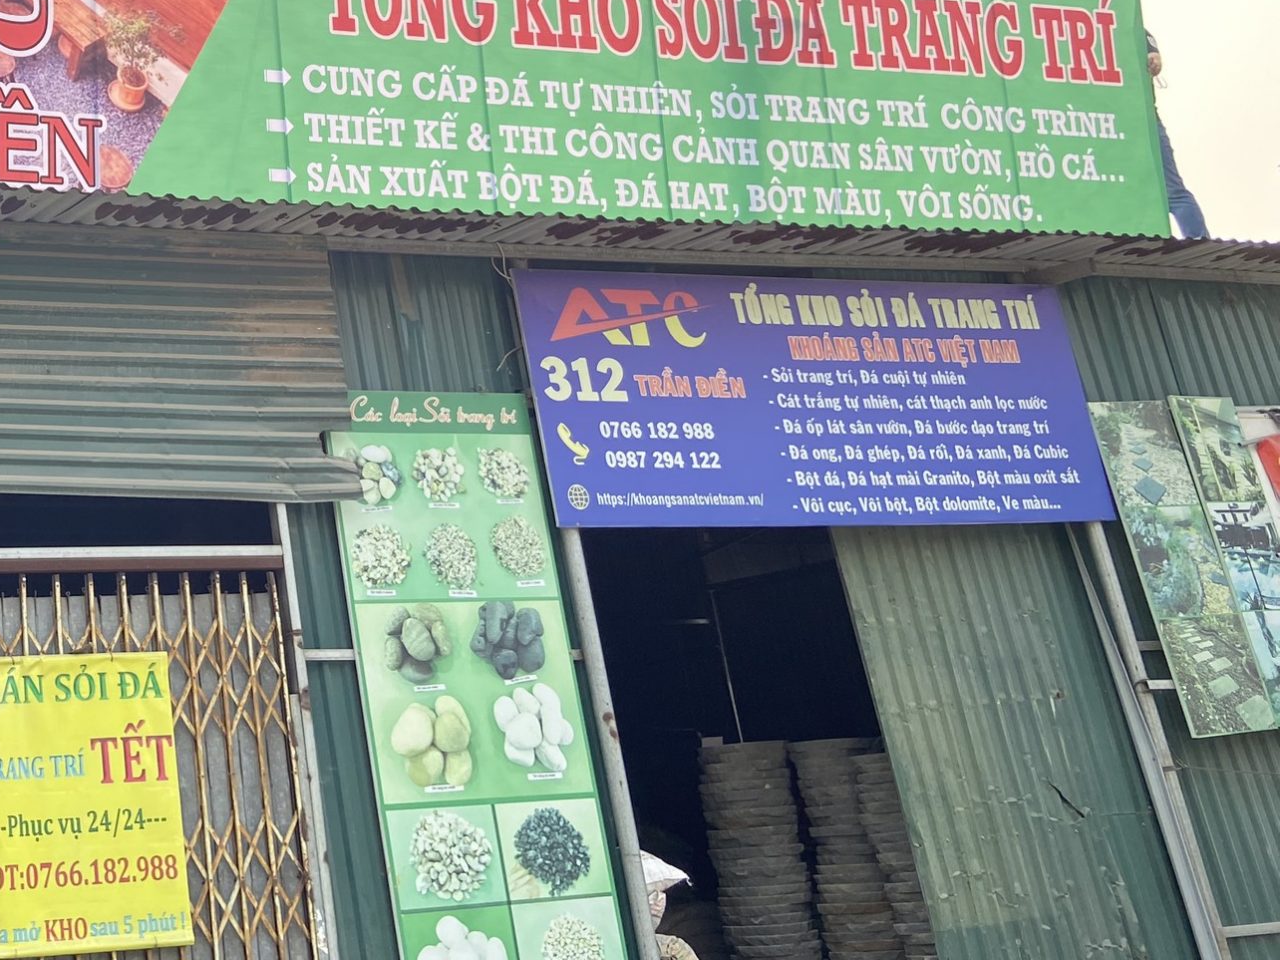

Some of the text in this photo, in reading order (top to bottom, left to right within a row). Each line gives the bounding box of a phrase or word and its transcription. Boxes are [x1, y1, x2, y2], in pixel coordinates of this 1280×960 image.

[302, 65, 1125, 140] CUNG CẤP ĐÁ TỰ NHIÊN, SỎI TRANG TRÍ CÔNG TRÌNH.
[303, 106, 405, 147] THIẾT
[414, 112, 458, 150] KẾ
[466, 122, 490, 152] &
[499, 124, 557, 156] THI
[565, 123, 663, 161] CÔNG
[672, 127, 760, 166] CẢNH
[766, 140, 851, 173] QUAN
[859, 138, 914, 172] SÂN
[921, 140, 1011, 182] VƯỜN,
[1018, 143, 1055, 178] HỒ
[307, 154, 371, 195] SẢN
[379, 159, 468, 199] XUẤT
[478, 163, 542, 209] BỘT
[550, 170, 608, 213] ĐÁ,
[615, 173, 663, 210] ĐÁ
[746, 176, 806, 221] BỘT
[814, 181, 892, 223] MÀU,
[897, 183, 953, 219] VÔI
[960, 183, 1043, 223] SỐNG.
[550, 287, 707, 348] ATC
[730, 283, 1041, 330] TỔNG KHO SỎI ĐÁ TRANG TRÍ
[788, 331, 1021, 368] KHOÁNG SẢN ATC VIỆT NAM
[540, 356, 747, 402] 312 TRẦN ĐIỀN
[771, 368, 794, 383] Sỏi
[797, 370, 833, 386] trang
[859, 369, 879, 384] Đá
[883, 371, 910, 386] cuội
[913, 371, 928, 386] tự
[931, 371, 966, 386] nhiên
[600, 421, 715, 439] 0766 182 988
[606, 451, 721, 469] 0987 294 122
[597, 493, 764, 508] https://khoangsanatcvietnam.vn/
[55, 664, 110, 703] SỎI
[118, 663, 164, 700] ĐÁ
[50, 748, 85, 778] TRÍ
[90, 720, 172, 784] TẾT
[58, 817, 82, 840] vụ
[12, 921, 40, 942] mở
[44, 917, 88, 942] KHO
[90, 919, 118, 936] sau
[123, 916, 133, 934] 5
[138, 912, 177, 939] phút
